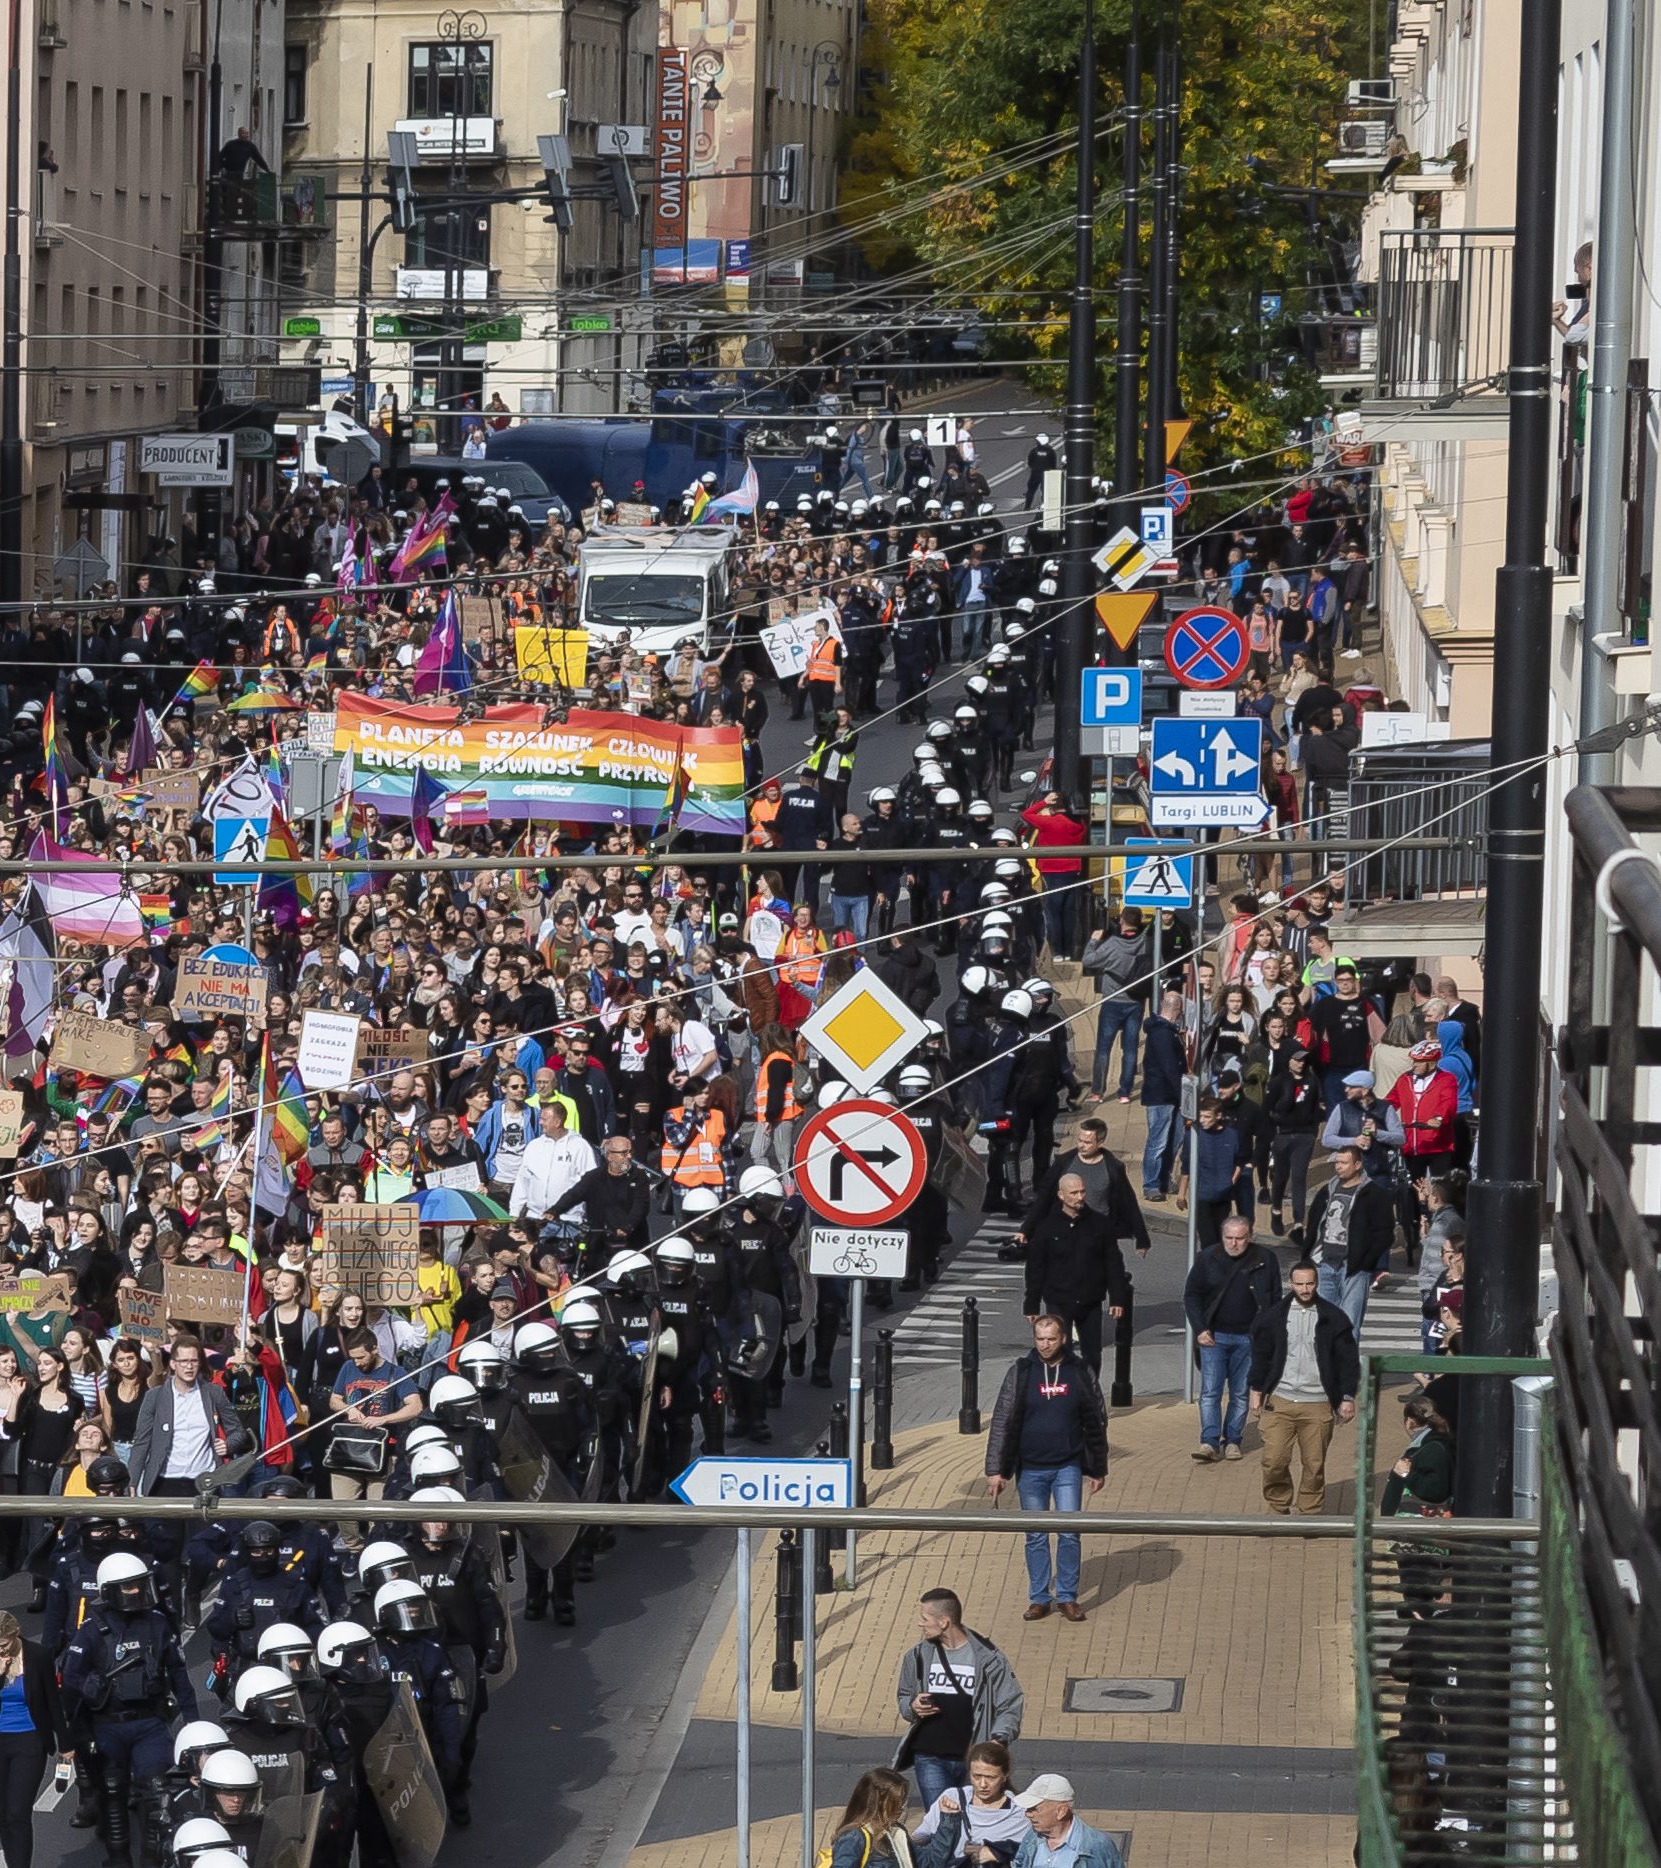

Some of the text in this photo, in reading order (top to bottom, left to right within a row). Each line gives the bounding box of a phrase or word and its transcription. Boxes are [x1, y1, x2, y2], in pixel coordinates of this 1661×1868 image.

[659, 52, 686, 220] TANIE PALIWO
[937, 420, 948, 443] 1
[144, 445, 216, 466] PRODUCENT
[1144, 516, 1162, 539] P
[1096, 672, 1130, 720] P
[359, 723, 465, 749] PLANETA
[485, 731, 594, 756] SZACUNEK
[608, 737, 698, 771] CZŁOWIK
[361, 747, 585, 778] ENERGIA RÓWNOŚĆ
[788, 797, 816, 809] POLICJA
[1160, 803, 1254, 821] Targi LUBLIN
[183, 960, 207, 978] BEZ
[200, 978, 251, 995] NIE MA
[60, 1027, 93, 1043] MAKE
[366, 1043, 391, 1058] NIE
[328, 1206, 413, 1238] MIŁUJ
[814, 1231, 906, 1256] Nie dotyczy
[326, 1236, 419, 1271] BLIŹNIEGO
[20, 1279, 41, 1291] NIE
[128, 1300, 156, 1318] HAS
[130, 1314, 152, 1327] NO
[528, 1391, 560, 1405] POLICJA
[718, 1471, 837, 1507] Policja
[251, 1753, 290, 1769] POLICJA
